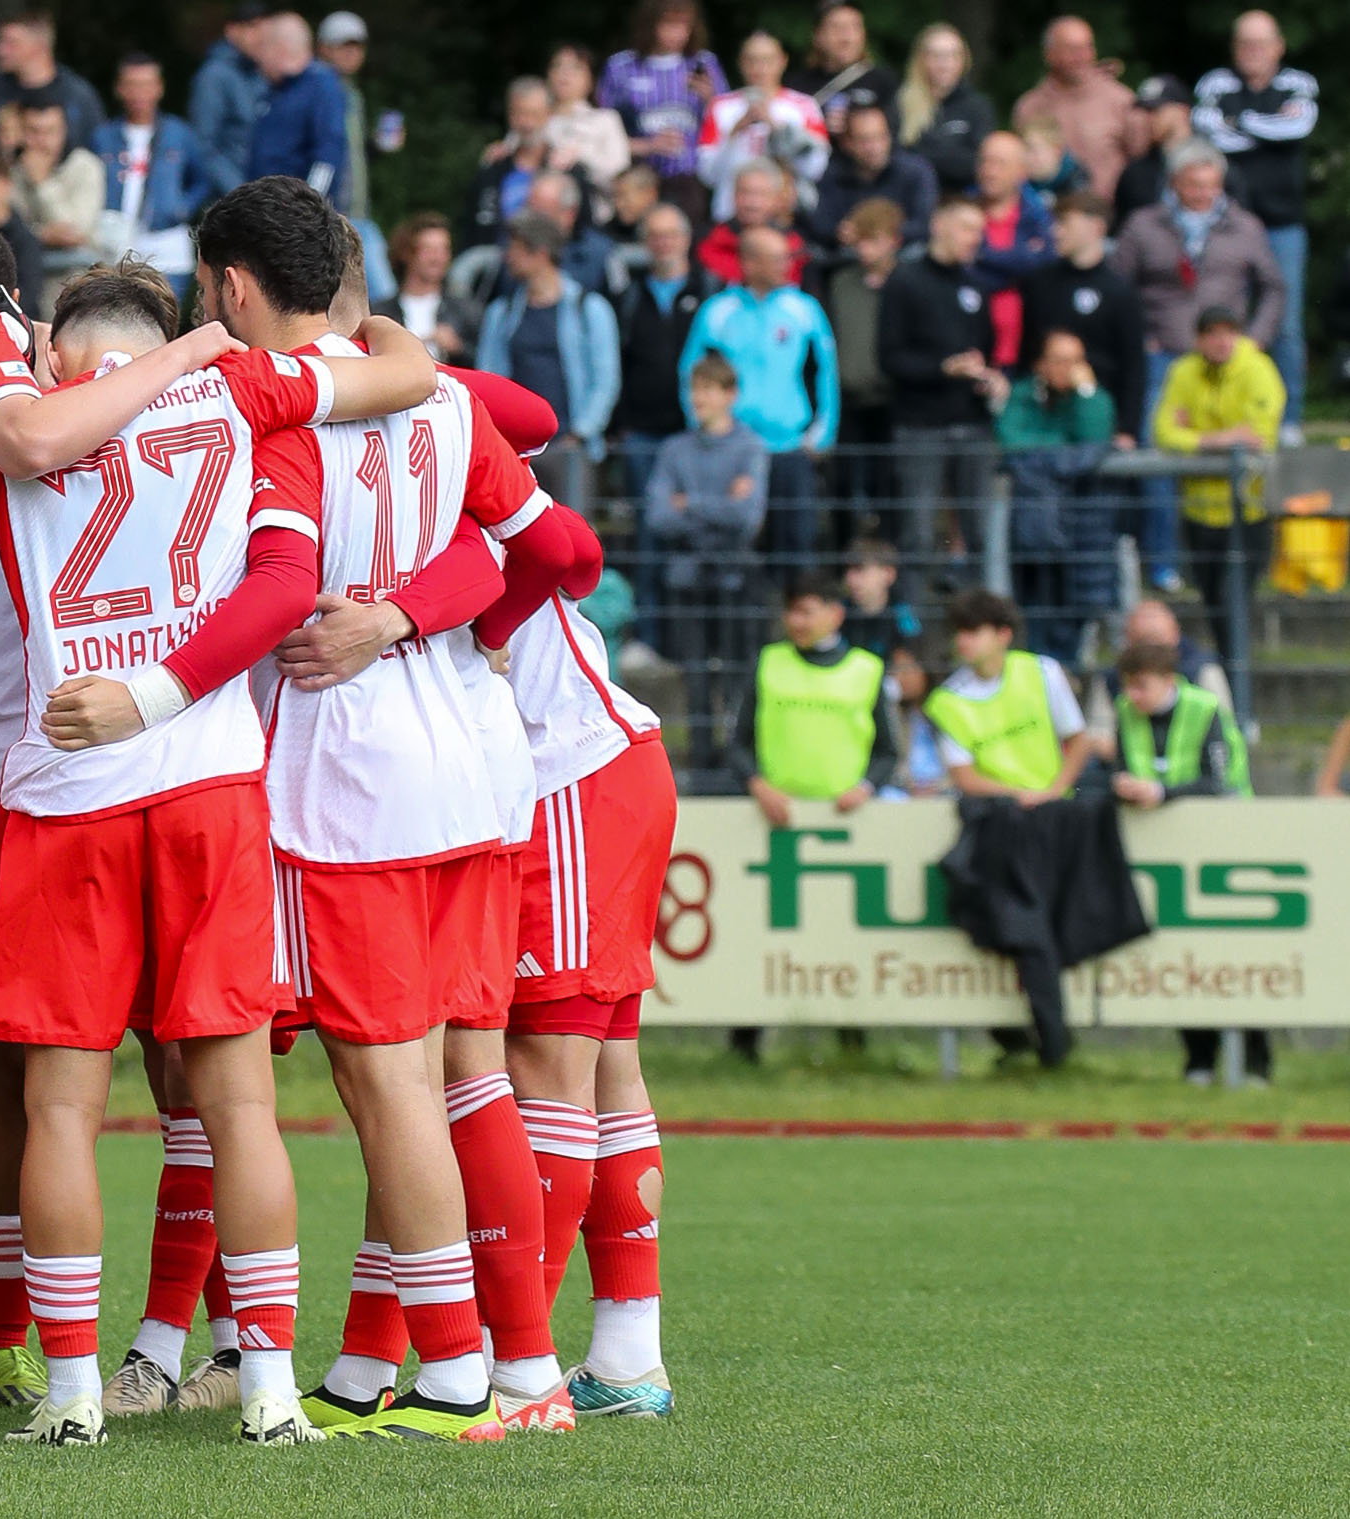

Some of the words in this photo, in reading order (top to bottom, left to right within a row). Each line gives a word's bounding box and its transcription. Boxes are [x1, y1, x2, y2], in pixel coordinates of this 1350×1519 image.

[37, 417, 237, 630] 27
[345, 419, 438, 605] 11
[765, 953, 855, 998] Ihre
